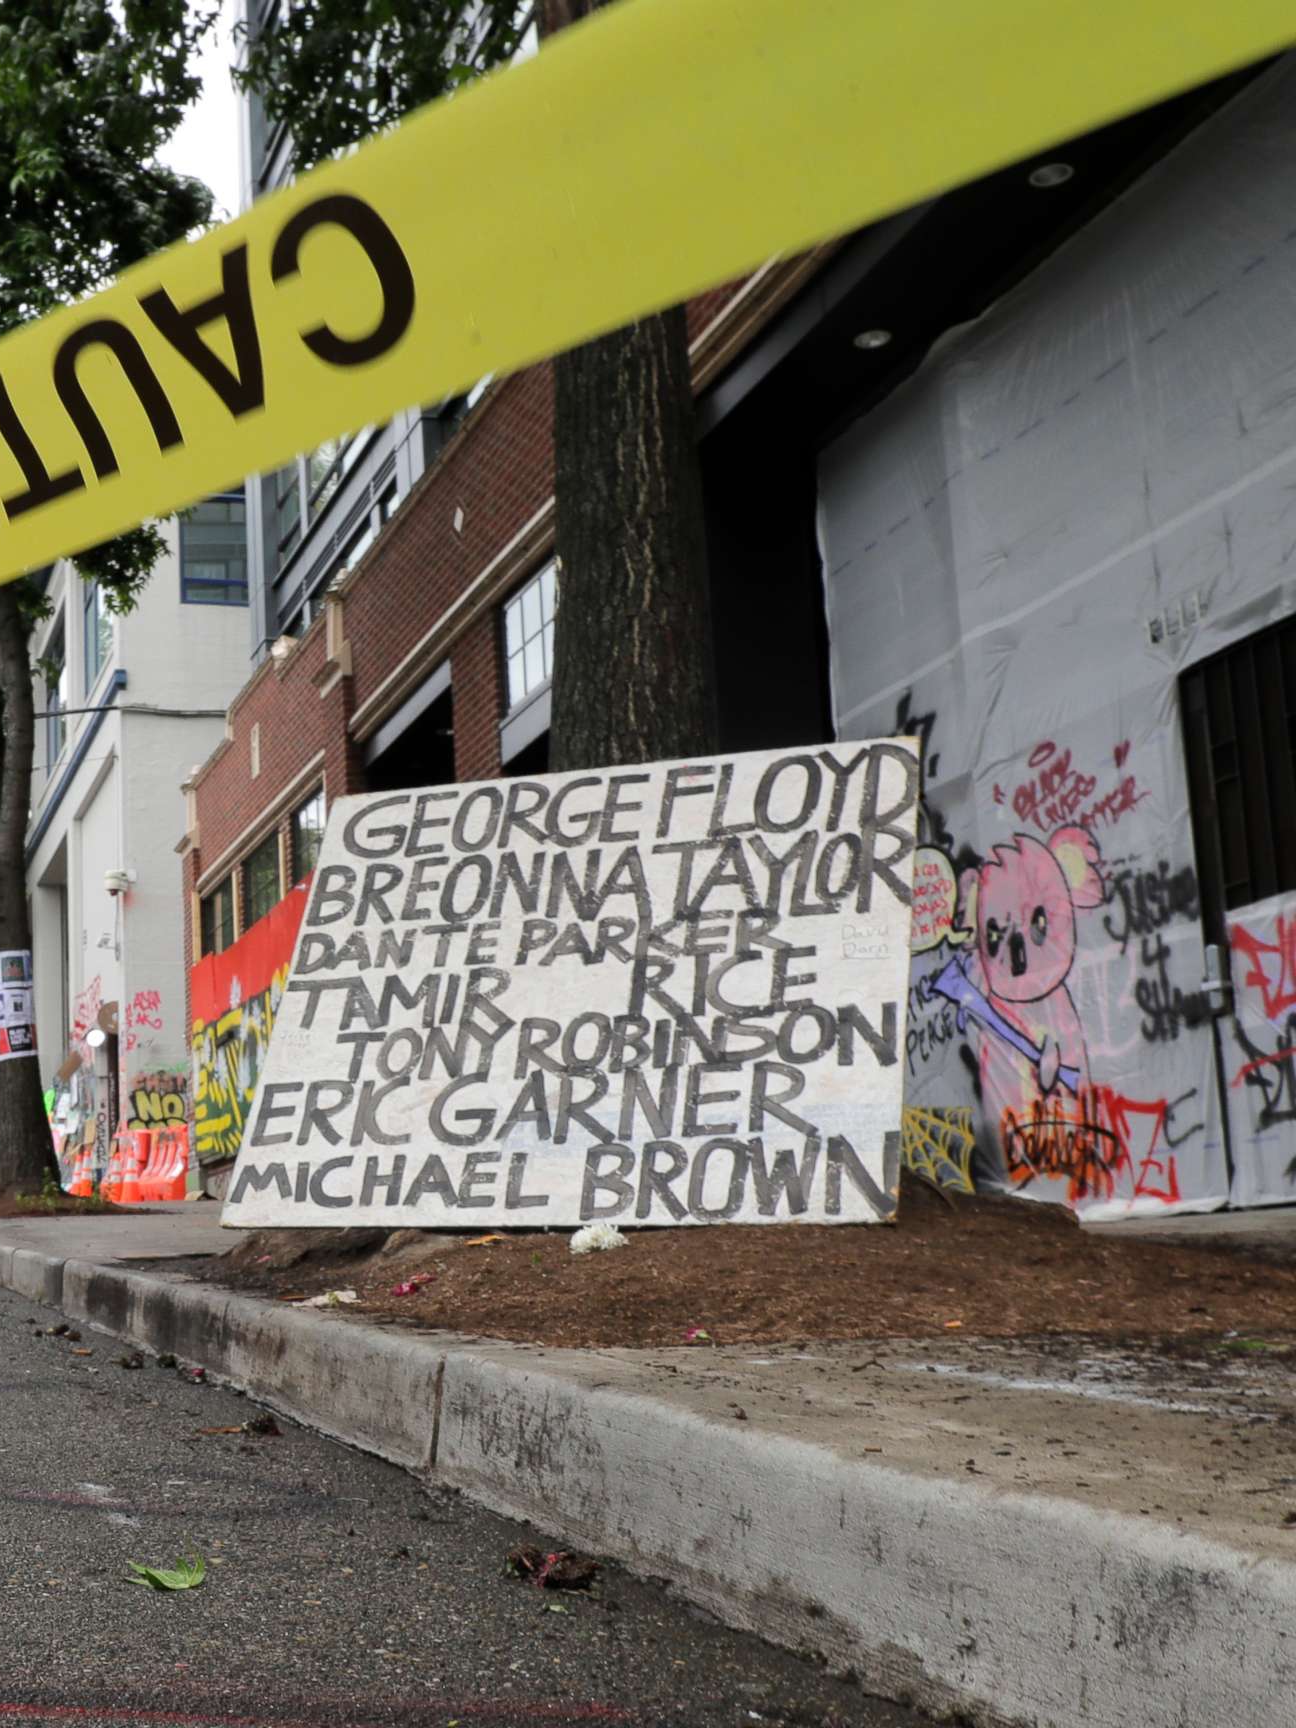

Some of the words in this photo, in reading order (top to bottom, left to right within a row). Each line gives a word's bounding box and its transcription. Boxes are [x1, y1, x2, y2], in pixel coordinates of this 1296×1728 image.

[344, 773, 650, 859] GEORGE
[657, 744, 917, 839] FLOYD
[307, 847, 652, 927] BREONNA
[654, 822, 915, 920] TAYLOR
[295, 921, 502, 975] DANTE
[515, 908, 794, 966] PARKER
[288, 967, 517, 1031] TAMIR
[629, 945, 818, 1019] RICE
[337, 1009, 517, 1083] TONY
[515, 1002, 897, 1080] ROBINSON
[250, 1078, 411, 1148] ERIC
[428, 1062, 818, 1146] GARNER
[230, 1152, 549, 1209] MICHAEL
[579, 1130, 901, 1222] BROWN
